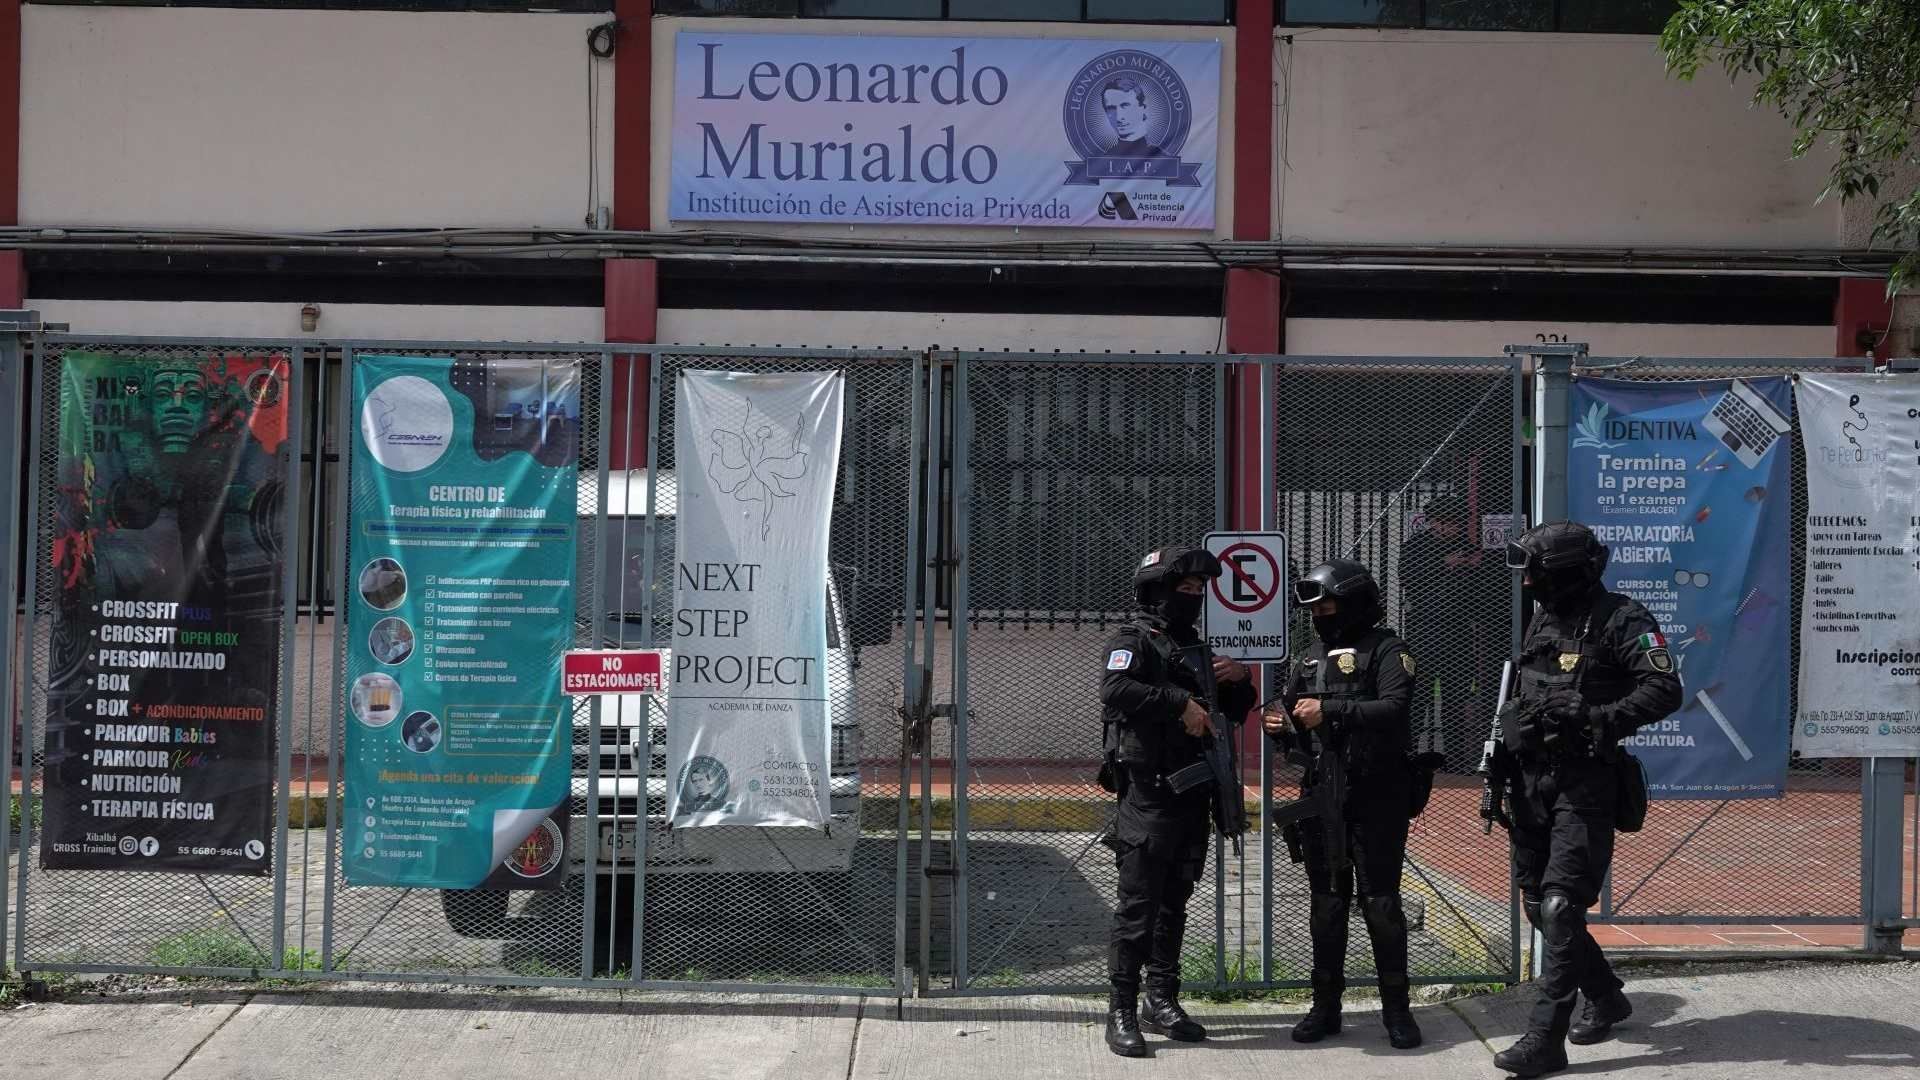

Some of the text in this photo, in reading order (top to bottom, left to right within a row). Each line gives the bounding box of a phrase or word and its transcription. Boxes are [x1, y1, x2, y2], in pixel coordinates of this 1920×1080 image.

[697, 43, 1008, 106] Leonardo
[1071, 56, 1184, 111] LEONARDO MURIALDO
[696, 122, 998, 185] Murialdo
[1132, 192, 1171, 202] Junta de
[687, 191, 1071, 220] Institución de Asistencia Privada
[1137, 202, 1185, 211] Asistencia
[1142, 213, 1177, 222] Privada
[1605, 420, 1697, 441] IDENTIVA
[1597, 453, 1686, 471] Termina
[1598, 473, 1686, 492] la prepa
[429, 486, 505, 503] CENTRO DE
[1597, 493, 1686, 505] en 1 examen
[390, 504, 430, 518] Terapia
[463, 508, 470, 519] y
[471, 506, 546, 519] rehabilitación
[1602, 505, 1638, 515] (Examen
[1853, 532, 1882, 541] Tareas
[678, 562, 761, 593] NEXT
[1617, 580, 1669, 589] CURSO DE
[438, 590, 478, 599] Tratamiento
[479, 592, 493, 600] con
[102, 600, 179, 620] CROSSFIT
[437, 605, 478, 613] Tratamiento
[437, 618, 478, 627] Tratamiento
[676, 608, 749, 638] STEP
[1238, 619, 1252, 632] NO
[101, 625, 239, 646] CROSSFIT OPEN BOX
[1209, 635, 1283, 649] ESTACIONARSE
[99, 650, 226, 670] PERSONALIZADO
[602, 657, 622, 672] NO
[435, 674, 459, 682] Cursos
[460, 675, 469, 683] de
[470, 675, 497, 684] Terapia
[676, 655, 815, 690] PROJECT
[98, 674, 130, 692] BOX
[568, 673, 658, 688] ESTACIONARSE
[96, 699, 128, 717] BOX
[146, 704, 264, 721] ACONDICIONAMIENTO
[708, 703, 793, 712] ACADEMIA DE DANZA
[1661, 720, 1680, 732] DE
[95, 724, 217, 744] PARKOUR Babies
[93, 749, 169, 768] PARKOUR
[92, 773, 181, 794] NUTRICIÓN
[421, 773, 440, 782] una
[443, 772, 463, 782] cita
[466, 773, 478, 783] de
[92, 799, 215, 821] TERAPIA FÍSICA
[86, 832, 117, 842] Xibalbá
[53, 843, 117, 855] CROSS Training
[192, 847, 243, 857] 6680-9641
